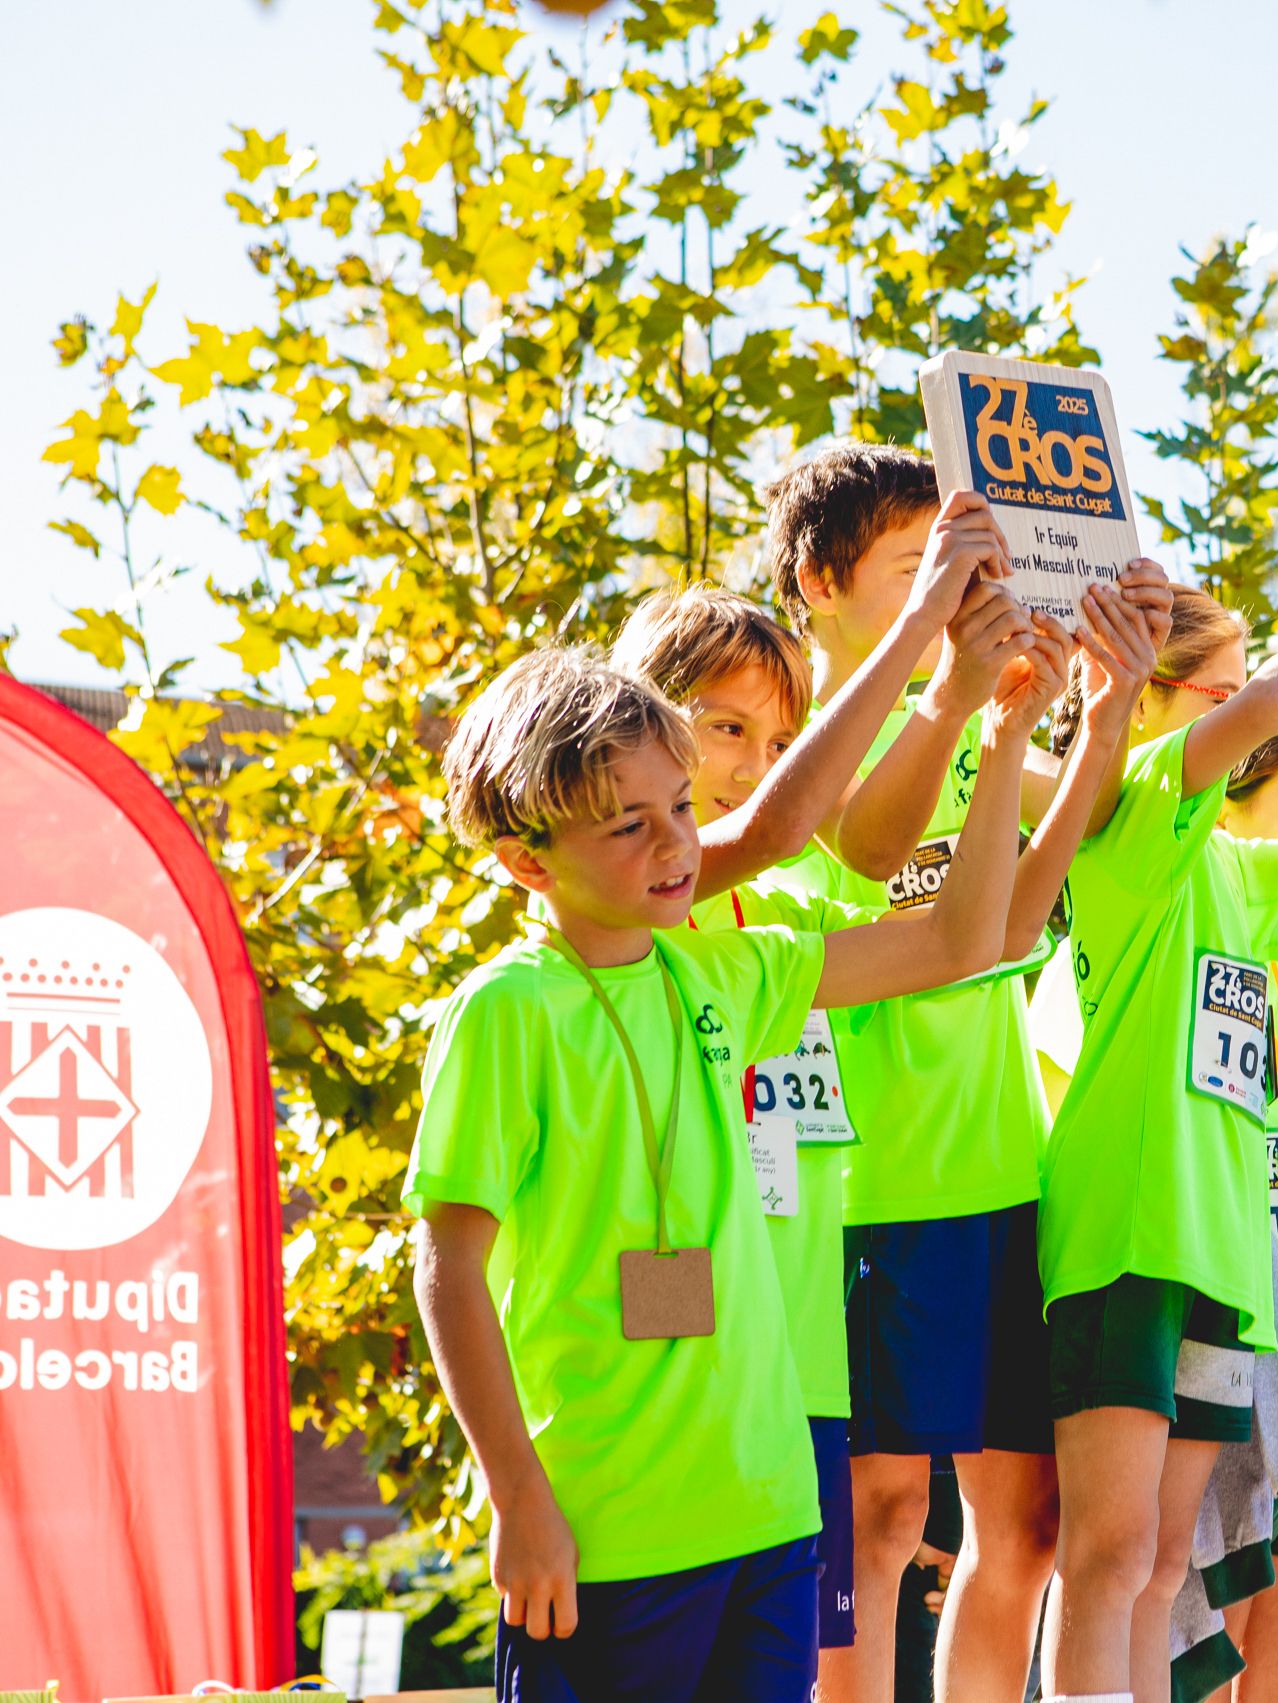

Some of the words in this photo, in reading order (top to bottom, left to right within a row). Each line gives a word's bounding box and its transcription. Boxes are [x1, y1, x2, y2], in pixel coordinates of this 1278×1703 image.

[1056, 395, 1089, 415] 2025
[976, 424, 1112, 493] CROS
[986, 483, 1025, 502] Ciutat
[1027, 488, 1044, 504] de
[1044, 489, 1075, 508] Sant
[1076, 494, 1112, 514] Cugat
[1047, 527, 1078, 551] Equip
[1033, 553, 1075, 575] Masculí
[1095, 561, 1119, 582] any)
[1209, 982, 1265, 1019] CROS
[1209, 1003, 1229, 1016] Ciutat
[1229, 1007, 1238, 1018] de
[1238, 1009, 1251, 1023] Sant
[1231, 1371, 1241, 1387] LA
[837, 1590, 850, 1612] la
